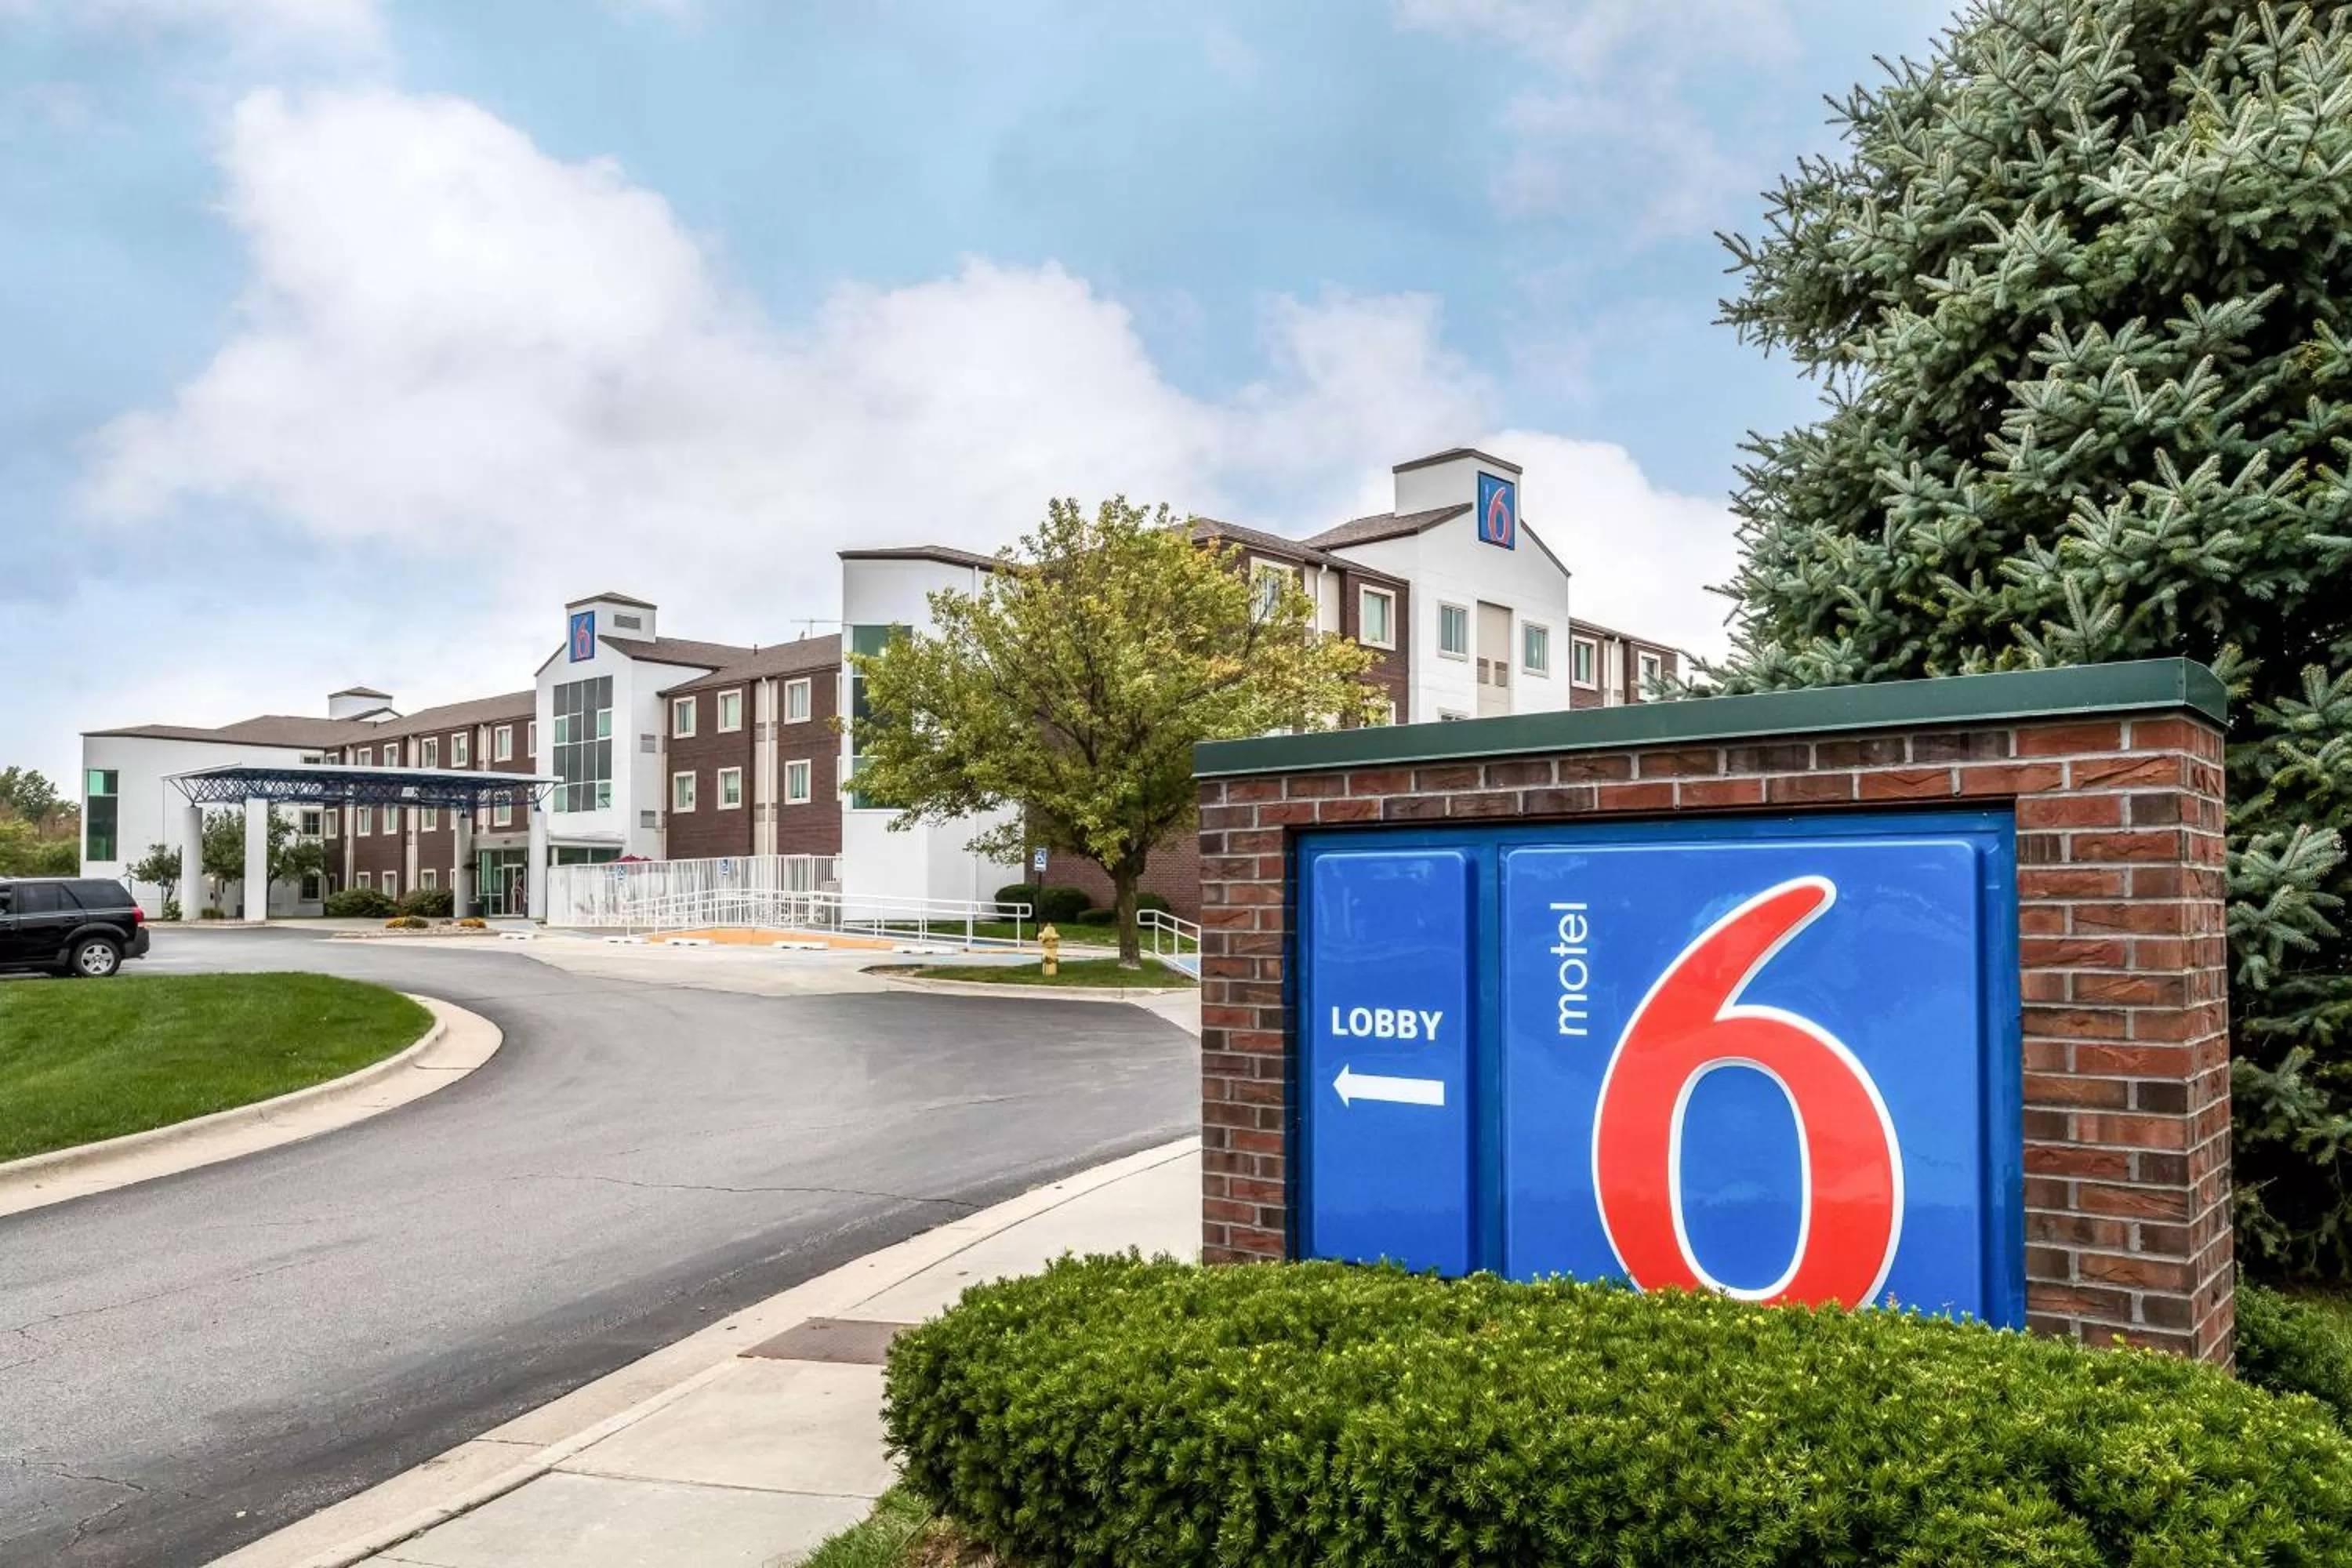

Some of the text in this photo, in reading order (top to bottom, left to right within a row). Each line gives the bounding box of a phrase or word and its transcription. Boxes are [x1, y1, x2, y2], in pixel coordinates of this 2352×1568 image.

[1488, 486, 1511, 545] 6
[576, 618, 590, 659] 6
[1550, 902, 1588, 1036] motel
[1332, 1006, 1443, 1040] LOBBY
[1592, 875, 1904, 1312] 6
